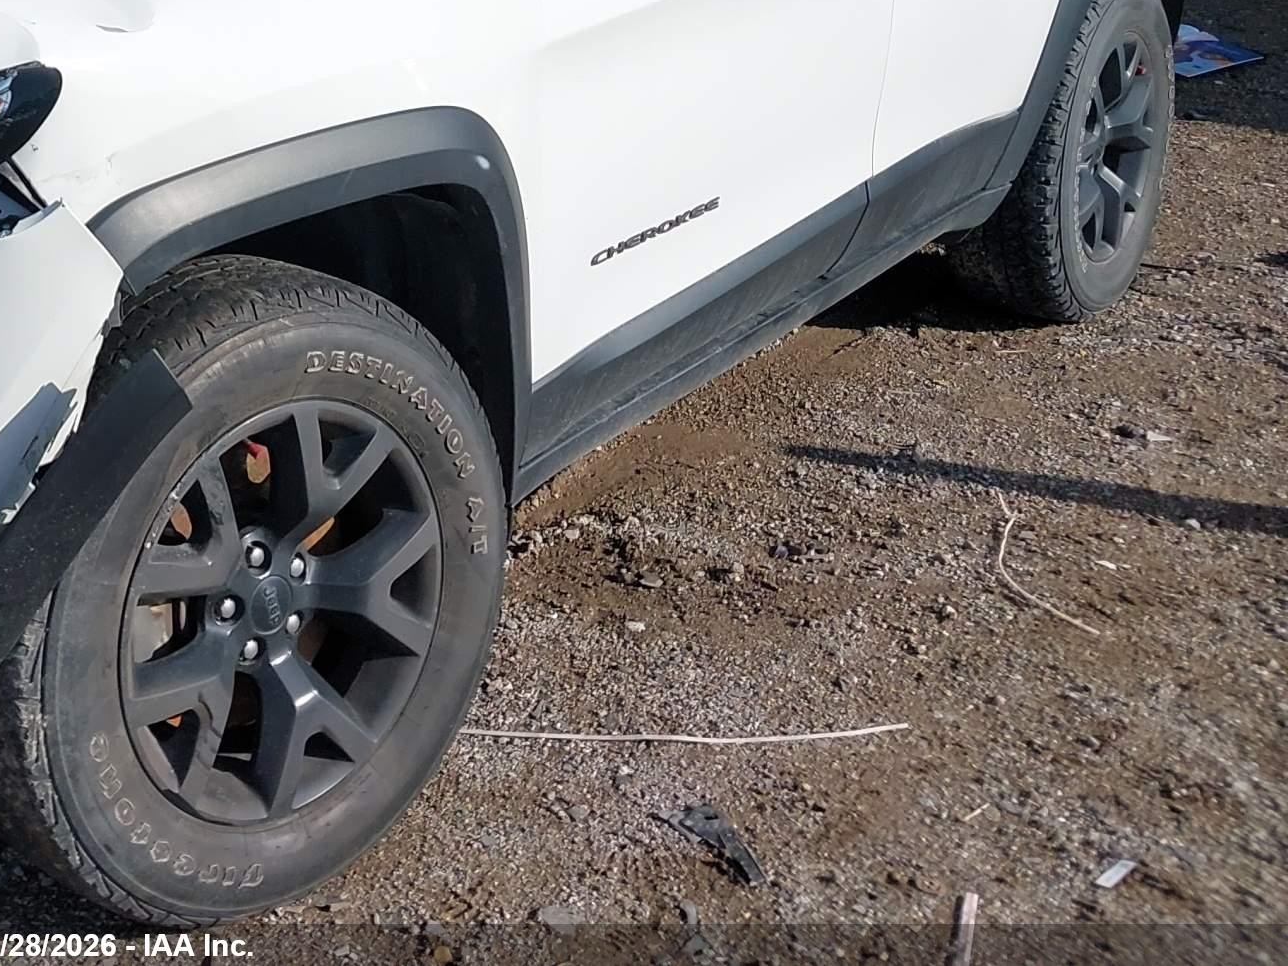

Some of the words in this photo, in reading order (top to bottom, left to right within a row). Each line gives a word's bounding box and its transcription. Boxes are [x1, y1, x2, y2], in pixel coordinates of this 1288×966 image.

[590, 196, 721, 267] CHEROKEE
[304, 349, 476, 479] DESTINATION
[263, 585, 282, 626] Jeep
[89, 733, 265, 890] Firestone
